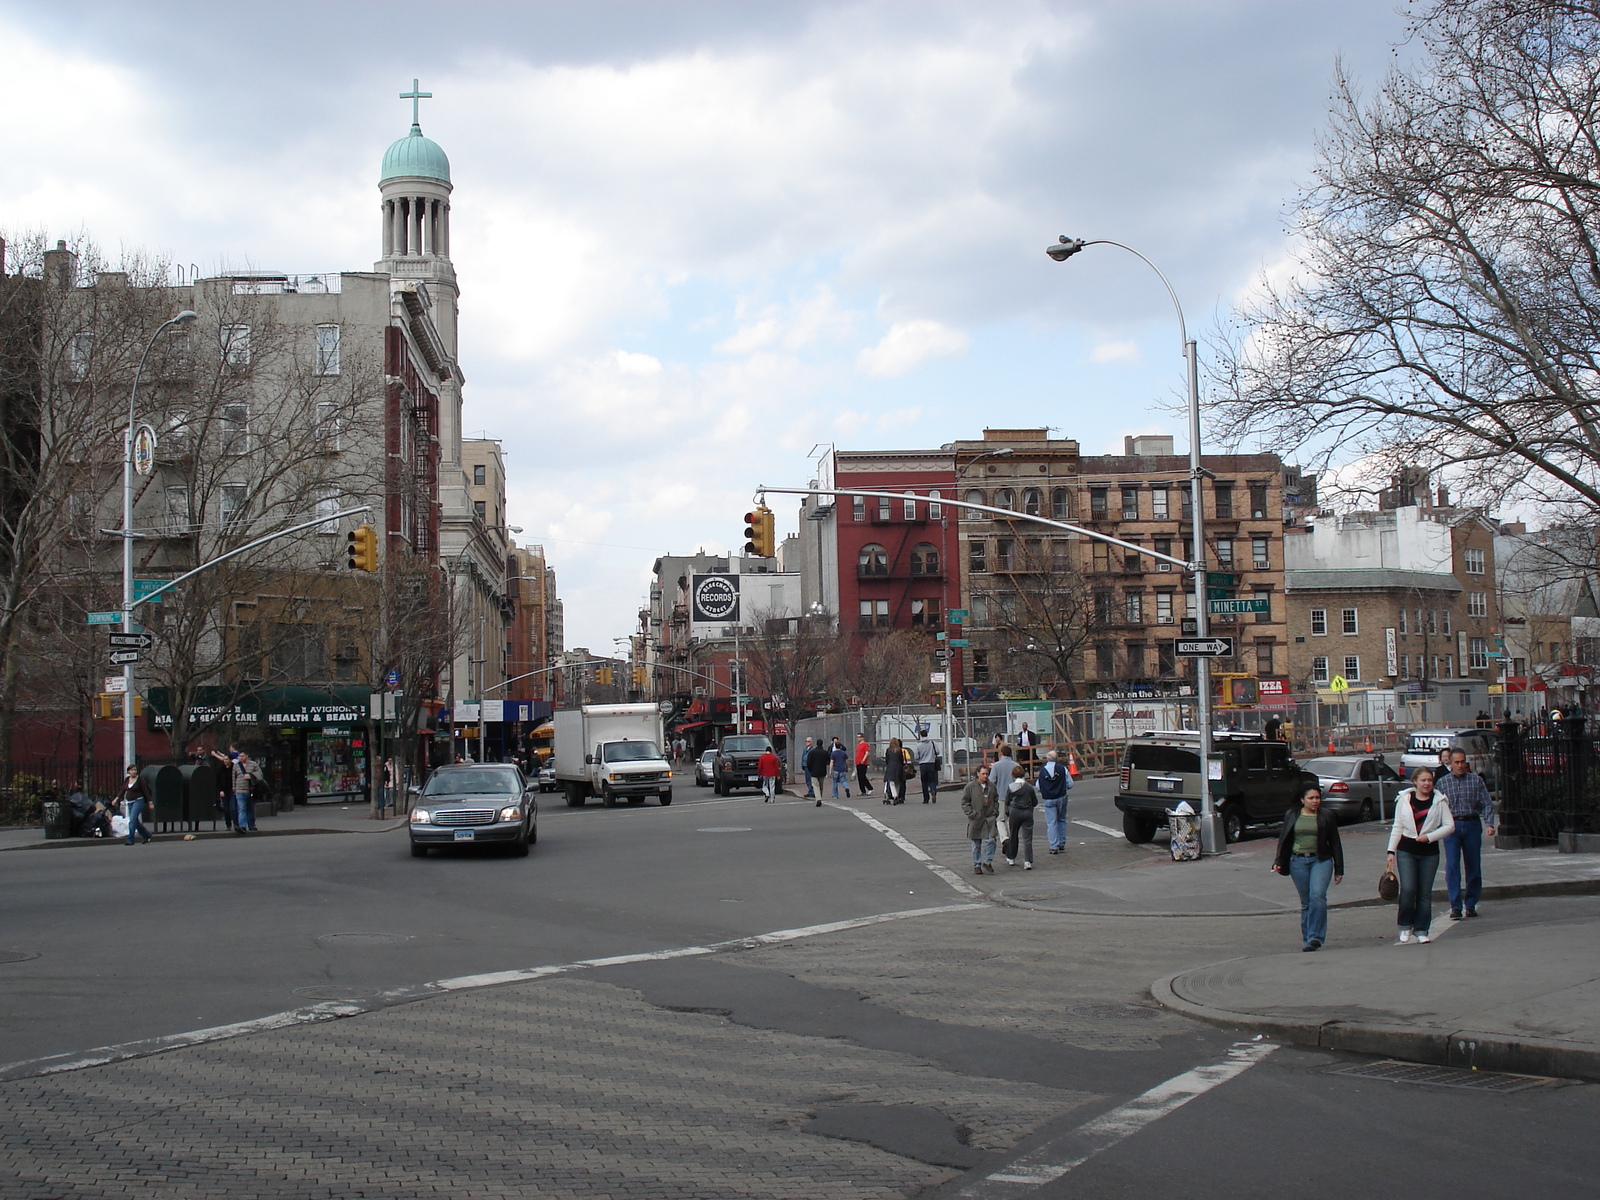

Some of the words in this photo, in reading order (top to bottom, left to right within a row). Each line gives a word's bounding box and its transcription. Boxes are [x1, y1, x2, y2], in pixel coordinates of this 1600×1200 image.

[702, 582, 730, 593] BLEECKER
[701, 593, 732, 602] RECORDS
[705, 605, 727, 613] STREET
[1214, 601, 1253, 613] MINETTA
[1184, 623, 1194, 631] ONE
[1206, 643, 1223, 651] WAY
[1259, 681, 1283, 691] IZZA
[1138, 690, 1153, 698] the
[235, 713, 257, 722] CARE
[268, 713, 308, 722] HEALTH
[312, 713, 321, 722] &
[1414, 737, 1450, 748] NYKB
